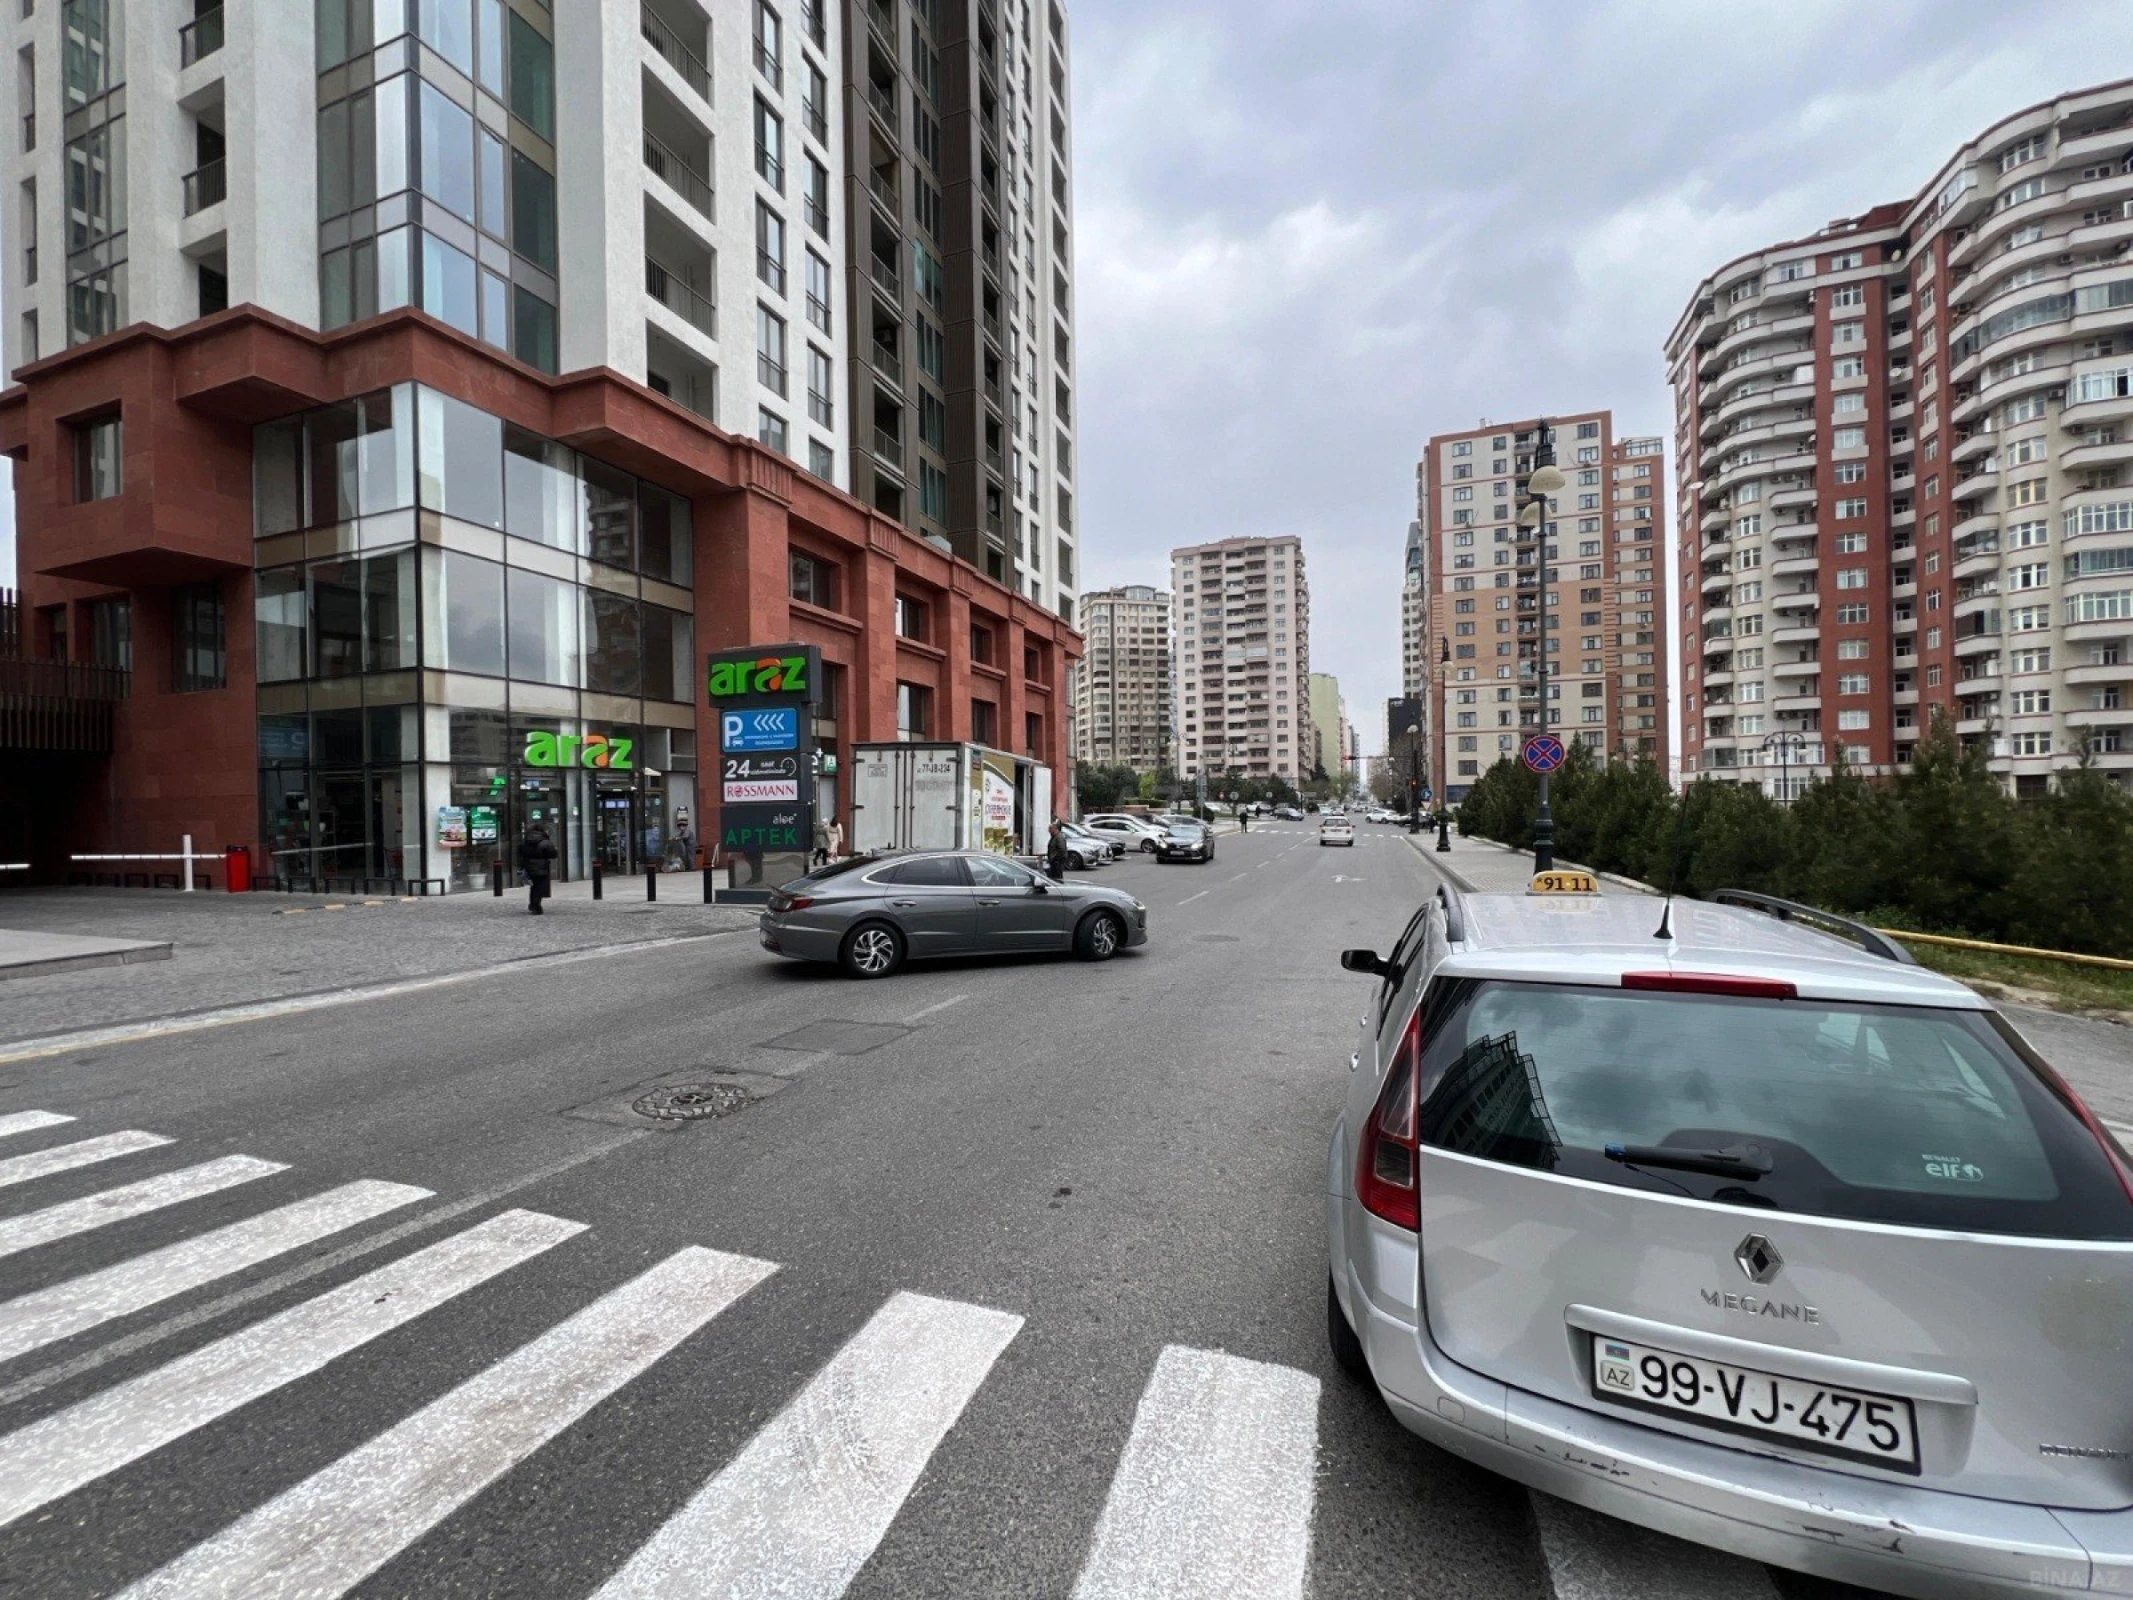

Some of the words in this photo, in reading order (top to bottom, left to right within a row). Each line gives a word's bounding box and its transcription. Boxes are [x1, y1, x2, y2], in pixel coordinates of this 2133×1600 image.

[710, 657, 806, 695] araz
[724, 716, 744, 748] P
[524, 731, 633, 769] araz
[725, 759, 750, 779] 24
[727, 784, 794, 798] ROSSMANN
[772, 813, 794, 825] aloe
[726, 827, 797, 846] APTEK
[1925, 1163, 1960, 1179] elf
[1700, 1288, 1820, 1326] MEGANE
[1605, 1367, 1630, 1386] AZ
[1640, 1355, 1900, 1451] 99-VJ-475
